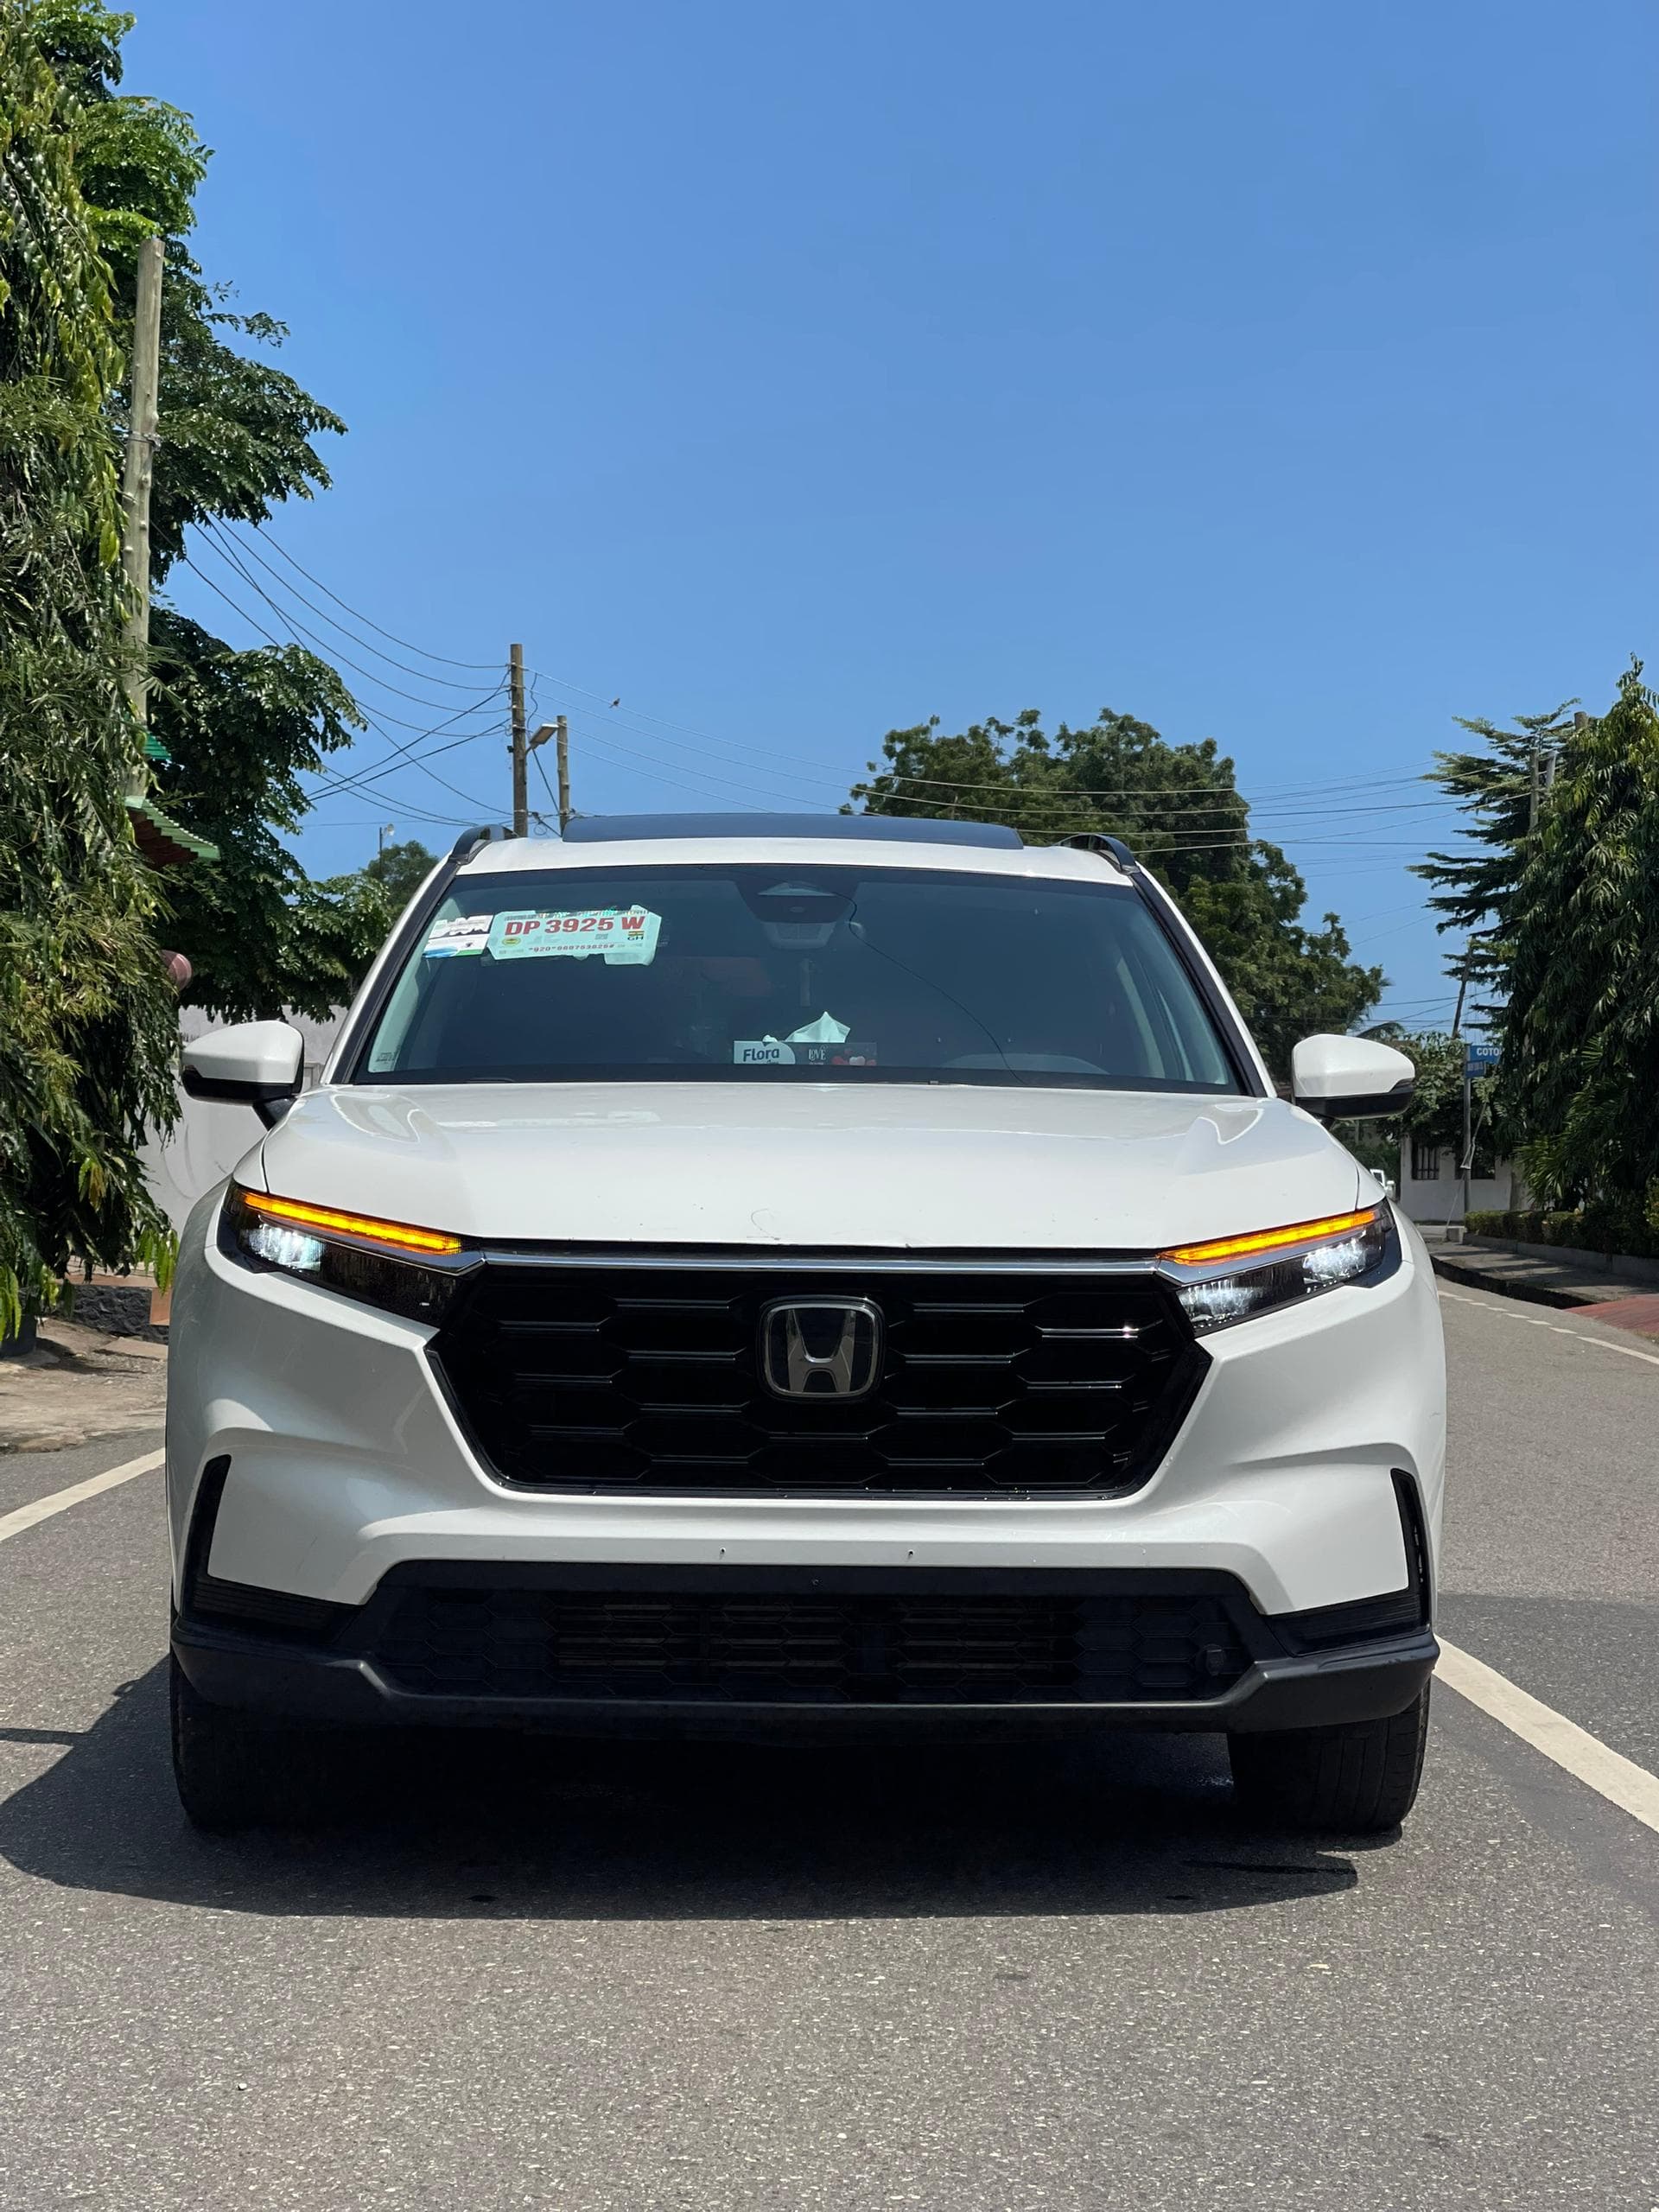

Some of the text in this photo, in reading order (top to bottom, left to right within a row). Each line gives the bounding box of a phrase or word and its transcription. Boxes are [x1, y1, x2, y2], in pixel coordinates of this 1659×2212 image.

[504, 920, 541, 936] DP
[544, 917, 615, 933] 3925
[621, 916, 646, 931] W
[743, 1048, 779, 1062] Flora
[1476, 1047, 1502, 1057] COTO
